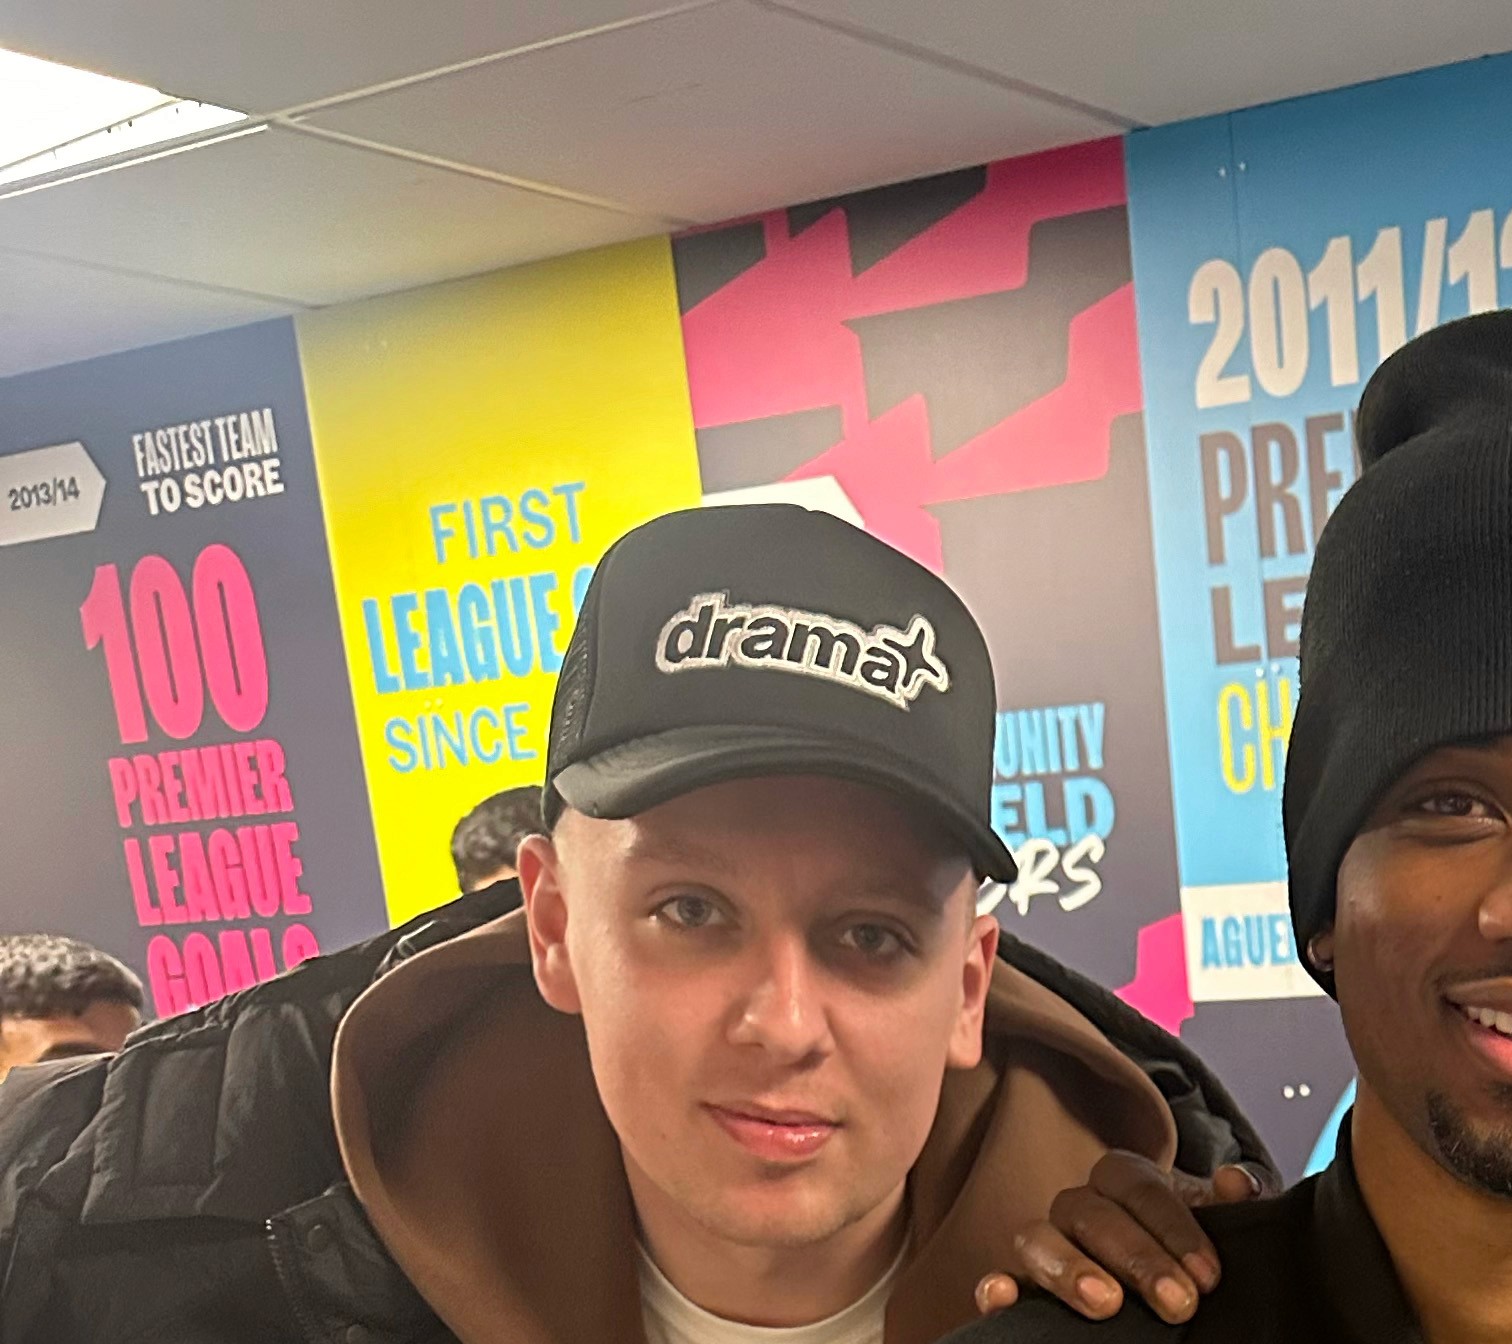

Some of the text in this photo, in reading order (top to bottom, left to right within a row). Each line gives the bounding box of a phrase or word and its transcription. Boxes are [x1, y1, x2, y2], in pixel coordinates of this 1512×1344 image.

[132, 408, 278, 477] FASTEST TEAM
[140, 458, 285, 516] TO SCORE
[1199, 408, 1362, 566] PRE
[8, 476, 80, 512] 2013/14
[430, 481, 586, 565] FIRST
[79, 543, 269, 745] 100
[362, 571, 564, 695] LEAGUE
[657, 596, 908, 704] drama
[384, 703, 538, 773] SINCE
[109, 739, 293, 828] PREMIER
[124, 822, 312, 927] LEAGUE
